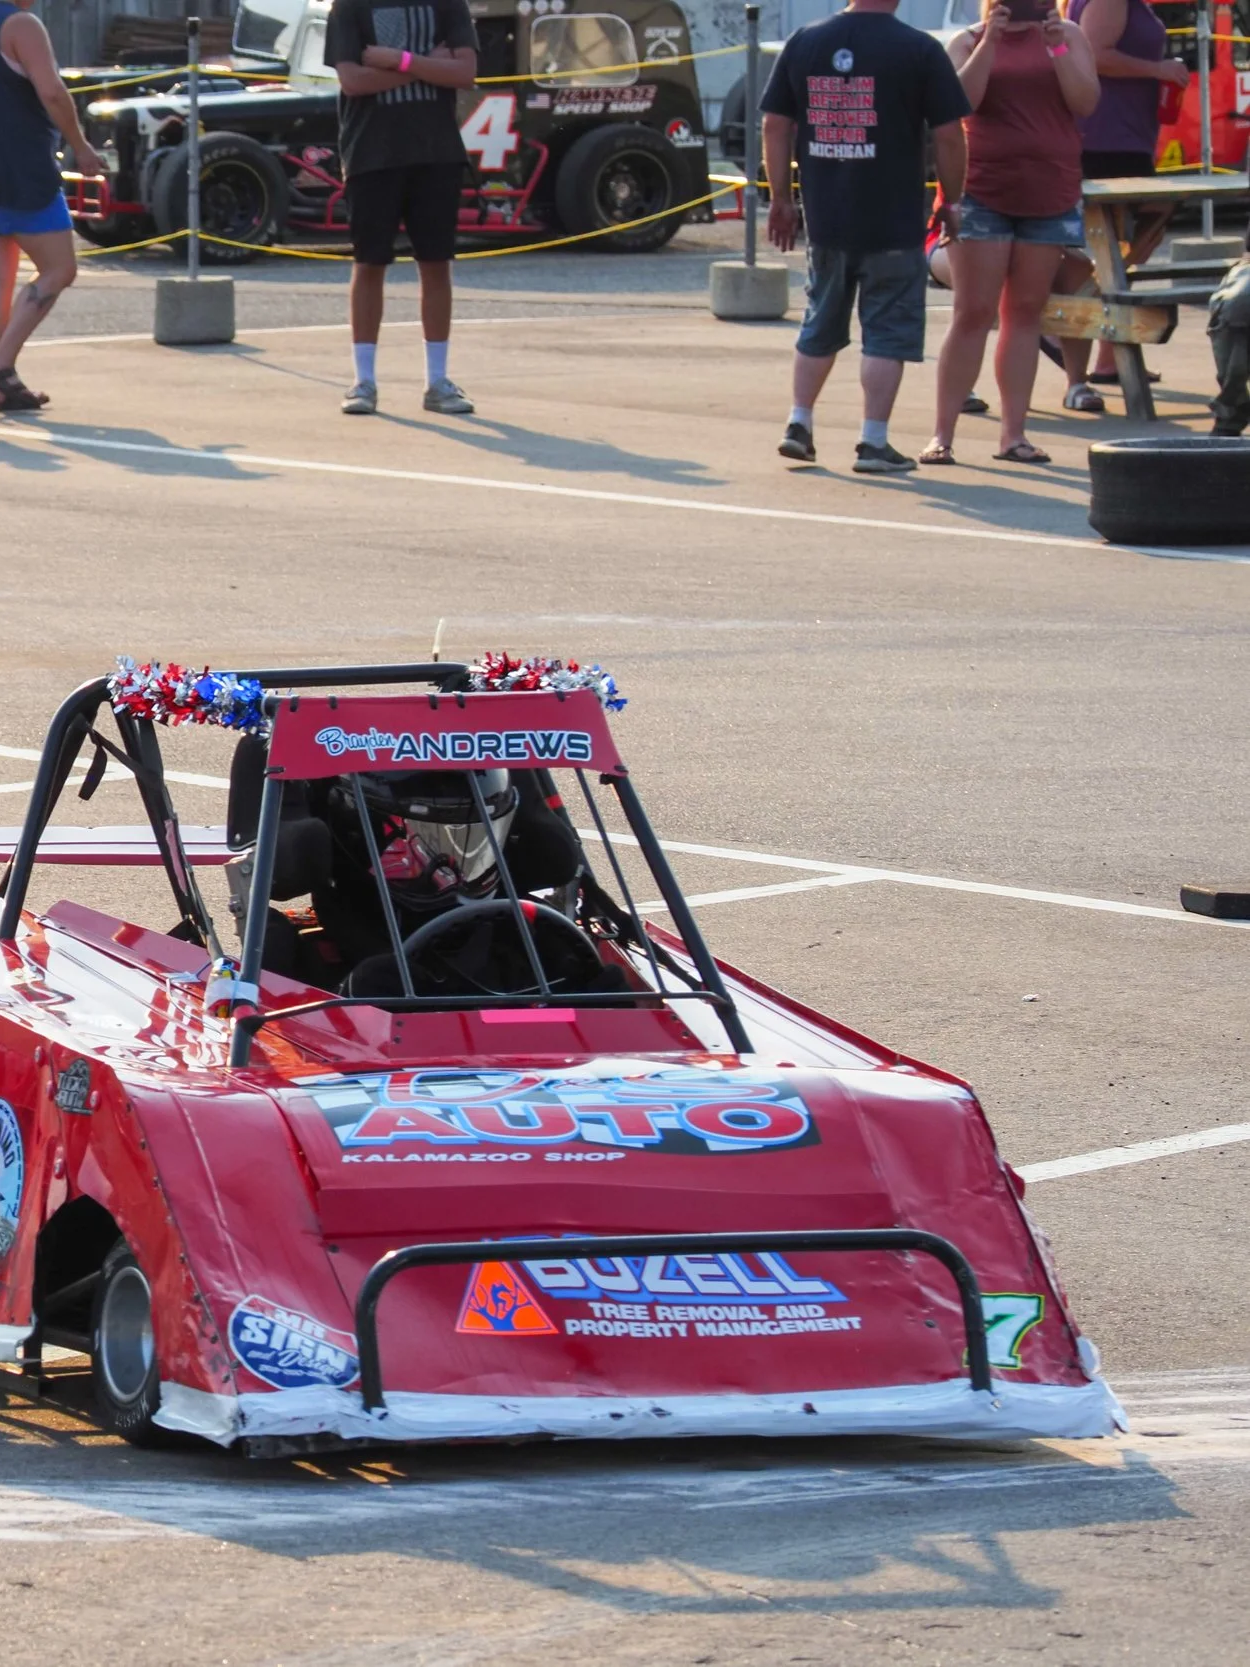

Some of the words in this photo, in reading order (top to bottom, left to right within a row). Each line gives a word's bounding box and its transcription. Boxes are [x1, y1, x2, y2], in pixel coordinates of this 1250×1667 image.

[553, 102, 604, 115] SPEED
[608, 100, 652, 113] SHOP
[460, 92, 520, 171] 4
[809, 141, 875, 158] MICHIGAN
[315, 727, 397, 761] Brayden
[391, 731, 592, 762] ANDREWS
[340, 1101, 810, 1146] AUTO
[341, 1151, 532, 1165] KALAMAZOO
[543, 1150, 627, 1164] SHOP
[273, 1307, 327, 1340] MR
[565, 1320, 688, 1338] PROPERTY
[695, 1316, 862, 1338] MANAGEMENT
[588, 1302, 650, 1321] TREE
[654, 1305, 769, 1321] REMOVAL
[774, 1303, 826, 1319] AND
[239, 1315, 349, 1373] SIGN
[962, 1292, 1045, 1370] 7
